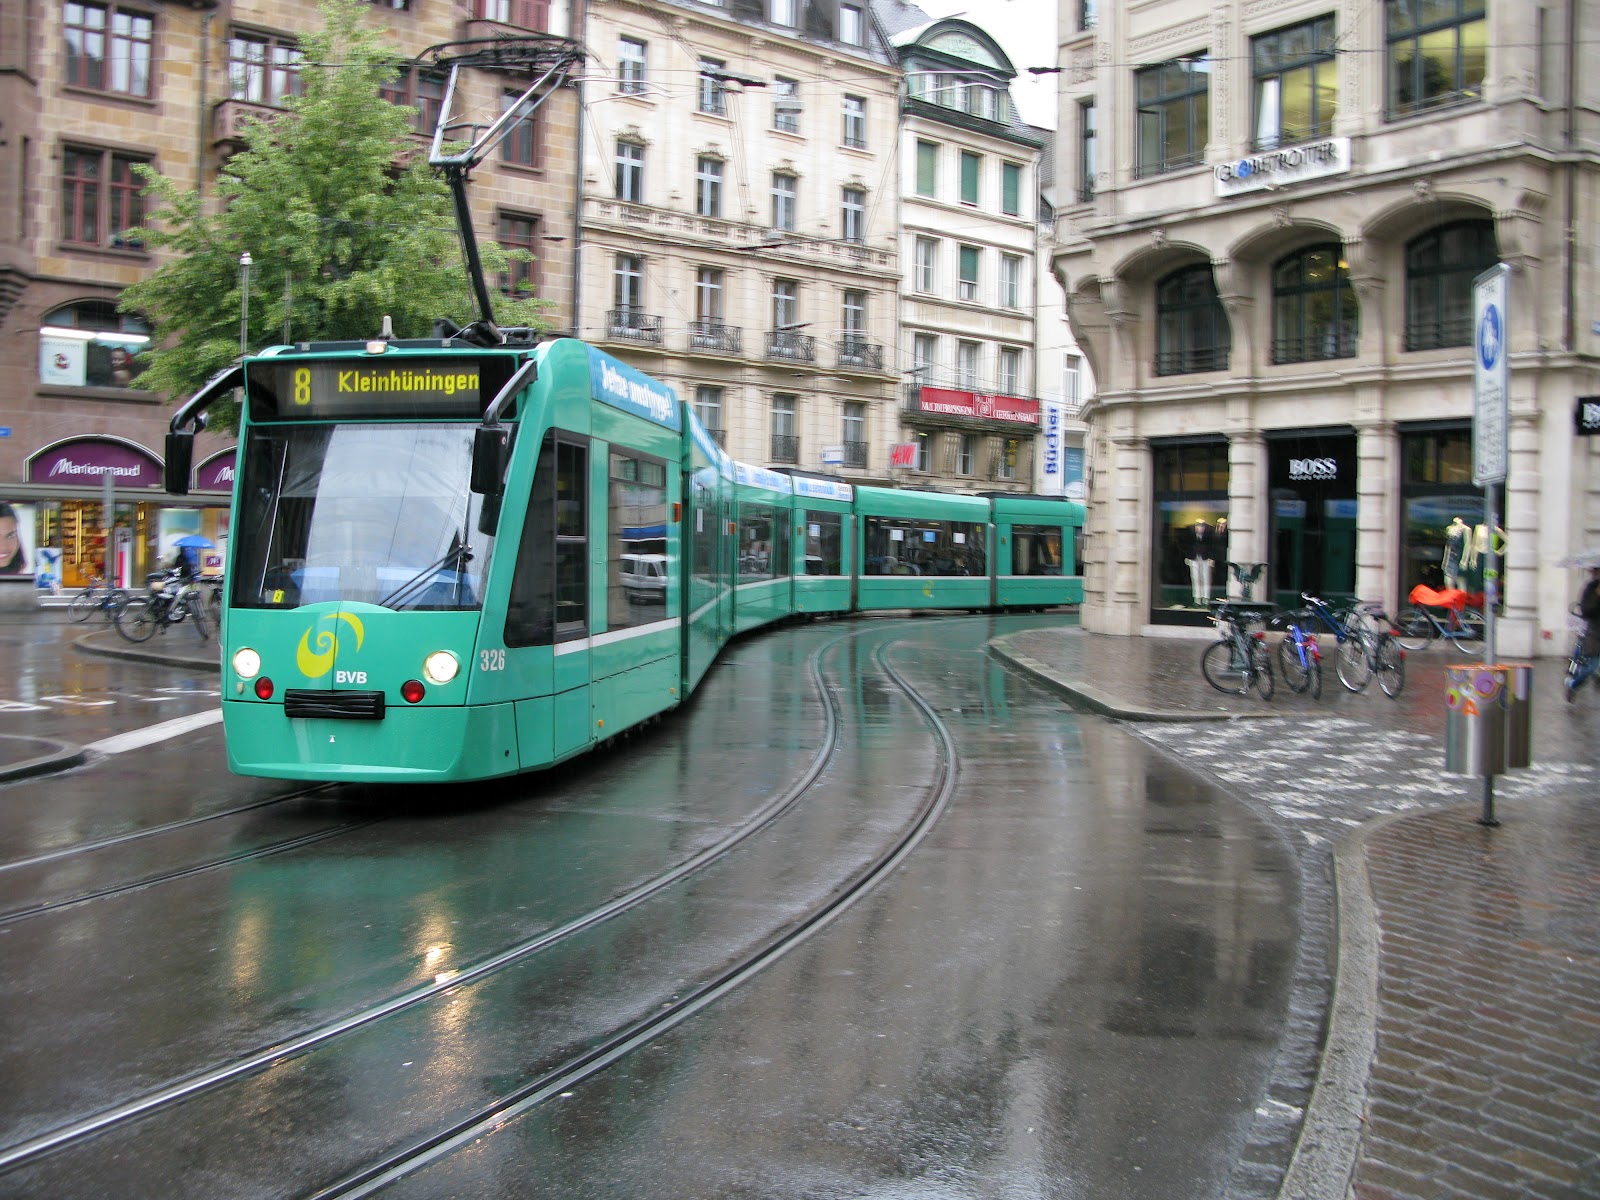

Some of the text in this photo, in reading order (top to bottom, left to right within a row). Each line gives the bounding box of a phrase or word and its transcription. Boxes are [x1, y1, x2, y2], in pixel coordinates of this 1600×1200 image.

[294, 367, 480, 405] 8 Kleinhüningen
[49, 457, 141, 477] Marionnaud
[1289, 457, 1337, 476] BOSS
[480, 649, 506, 671] 326
[336, 670, 367, 684] BVB
